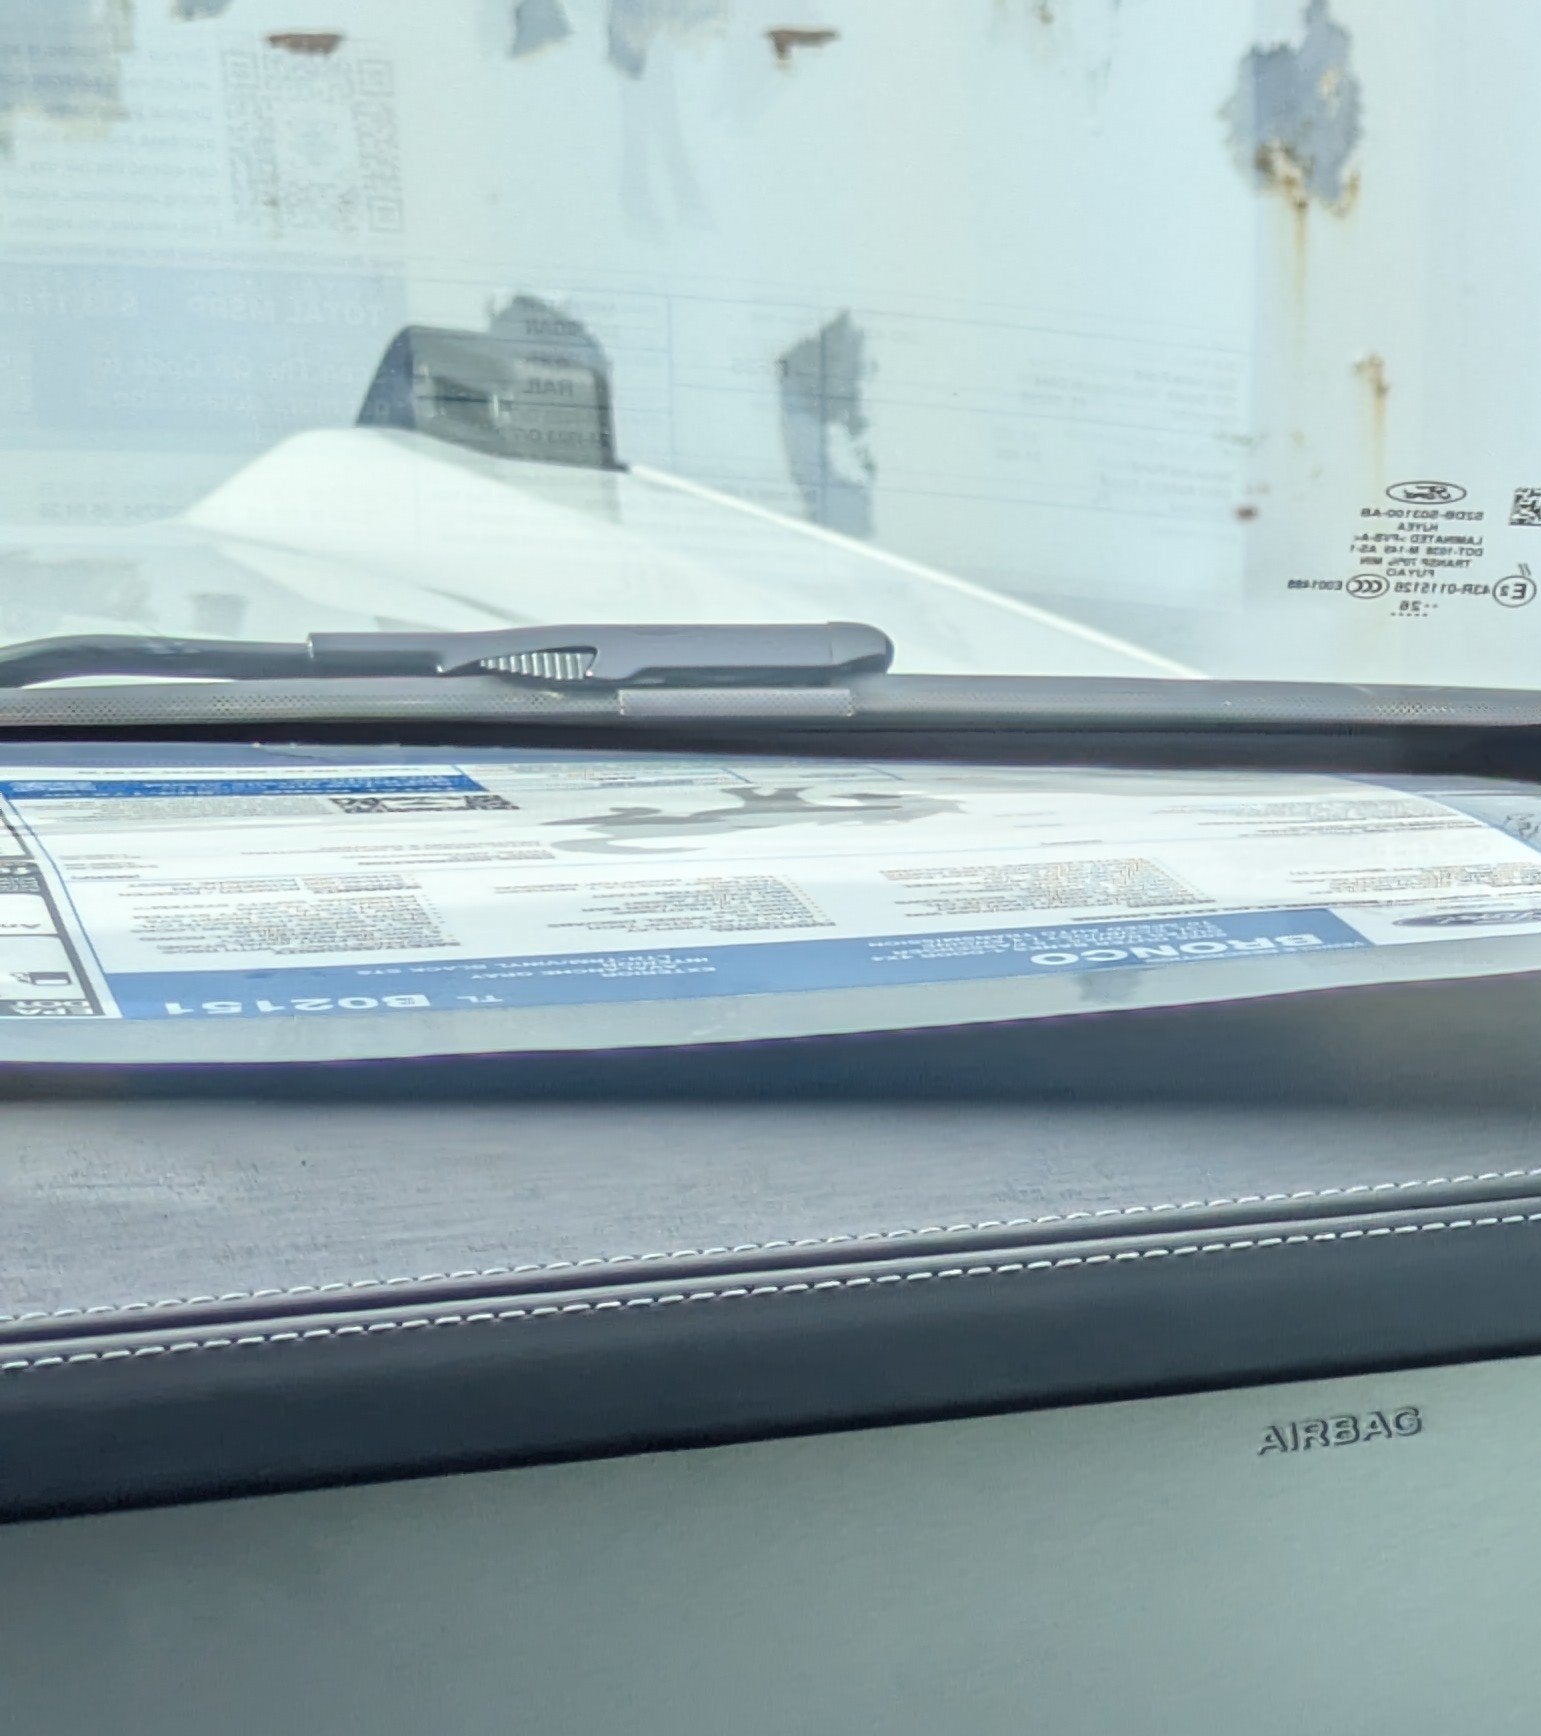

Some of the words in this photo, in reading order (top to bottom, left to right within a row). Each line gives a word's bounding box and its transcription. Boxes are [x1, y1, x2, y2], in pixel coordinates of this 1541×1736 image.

[1030, 934, 1323, 965] BRONCO
[163, 994, 431, 1015] B02151
[1257, 1407, 1424, 1456] AIRBAG
